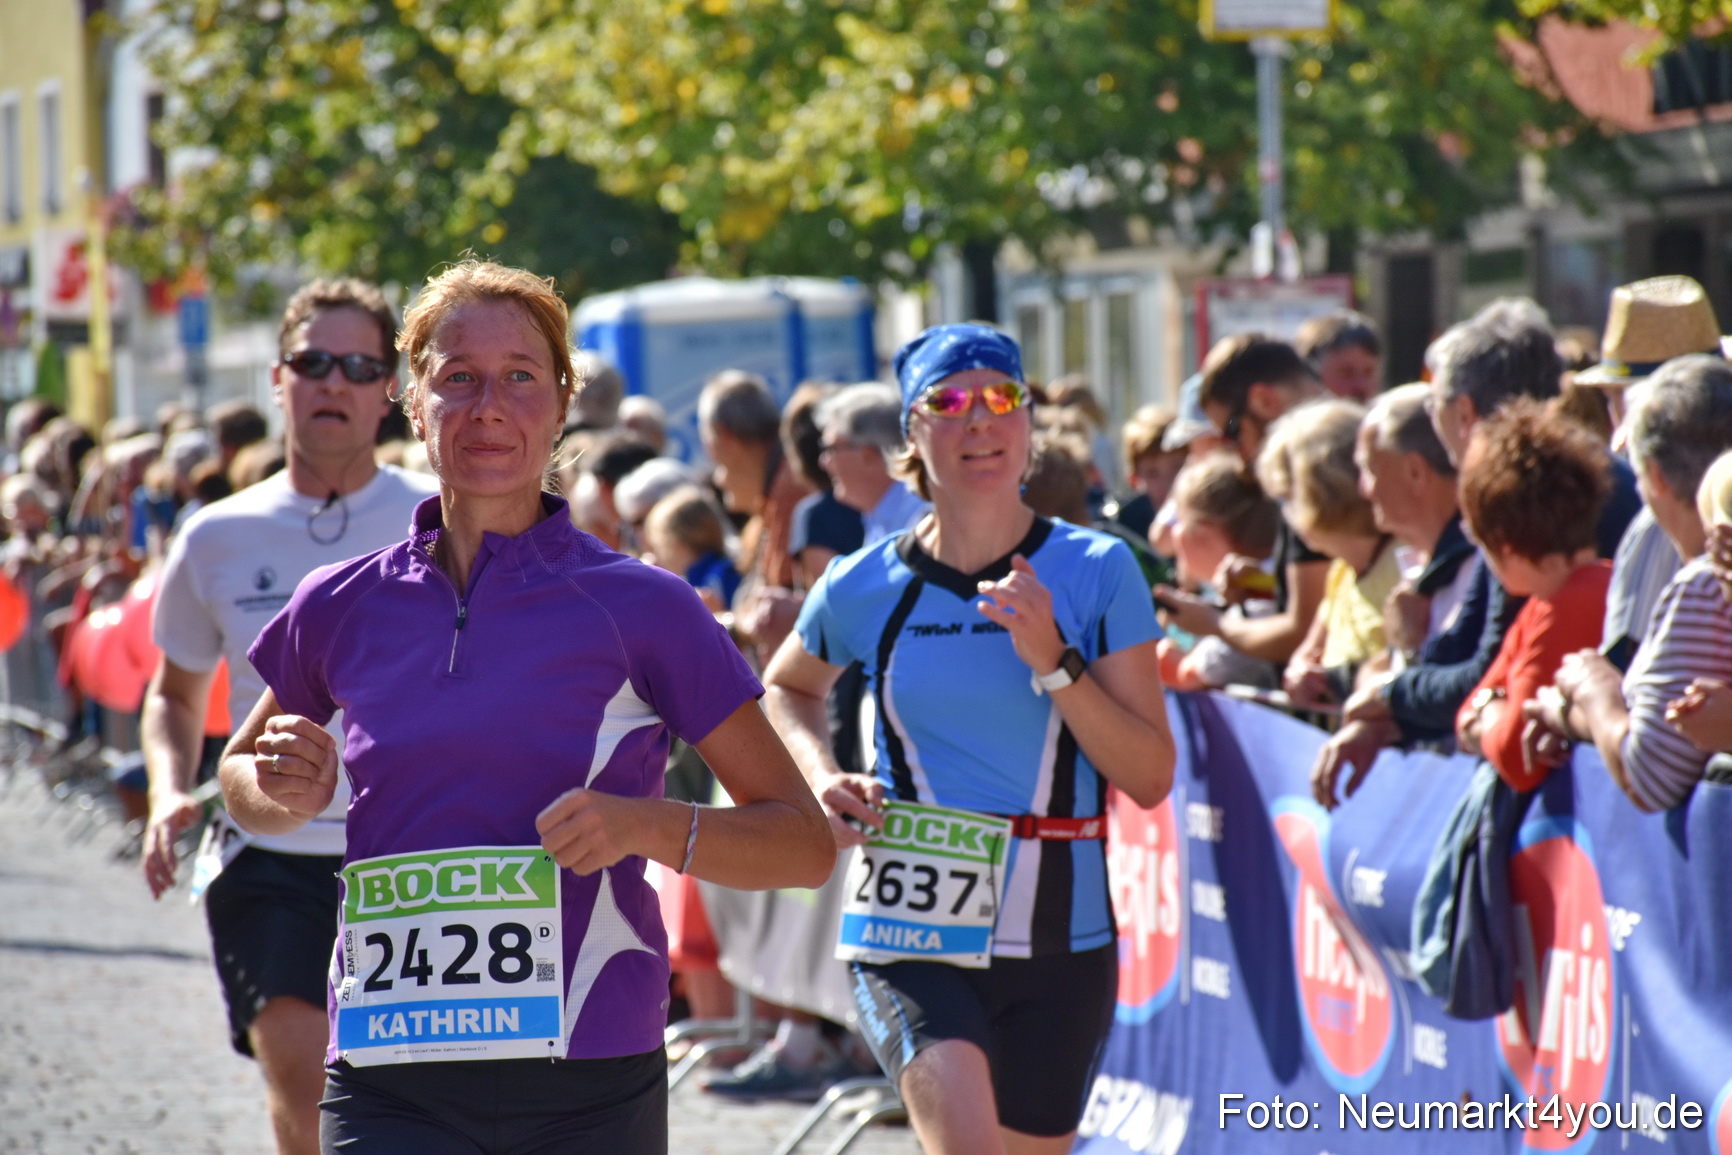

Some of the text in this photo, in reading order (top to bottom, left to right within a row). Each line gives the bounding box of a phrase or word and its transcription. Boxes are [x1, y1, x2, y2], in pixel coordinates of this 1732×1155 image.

[869, 808, 990, 858] OCK
[357, 856, 540, 914] BOCK
[855, 856, 979, 917] 2637
[363, 922, 534, 992] 2428
[539, 926, 550, 938] D
[860, 921, 943, 950] ANIKA
[368, 1006, 520, 1040] KATHRIN
